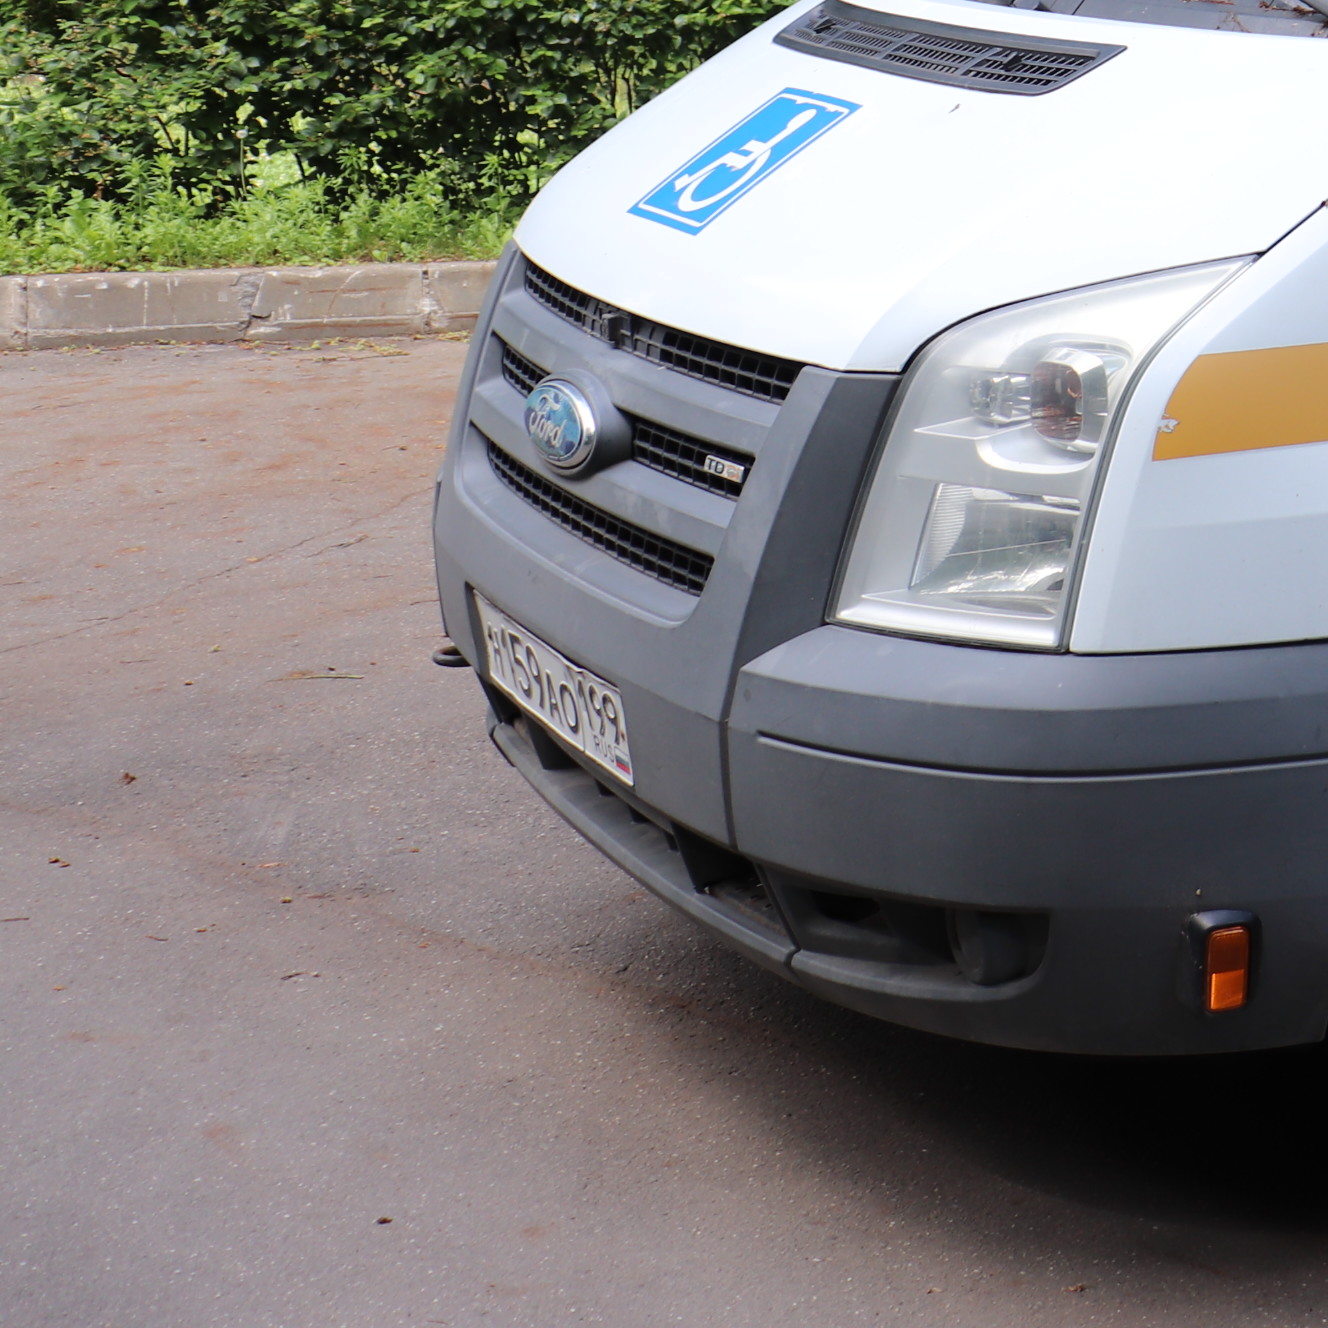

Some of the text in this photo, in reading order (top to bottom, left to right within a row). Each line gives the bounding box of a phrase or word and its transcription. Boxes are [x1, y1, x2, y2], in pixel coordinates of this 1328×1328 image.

[529, 393, 568, 448] Ford
[577, 676, 621, 746] 199
[594, 733, 615, 763] RUS
